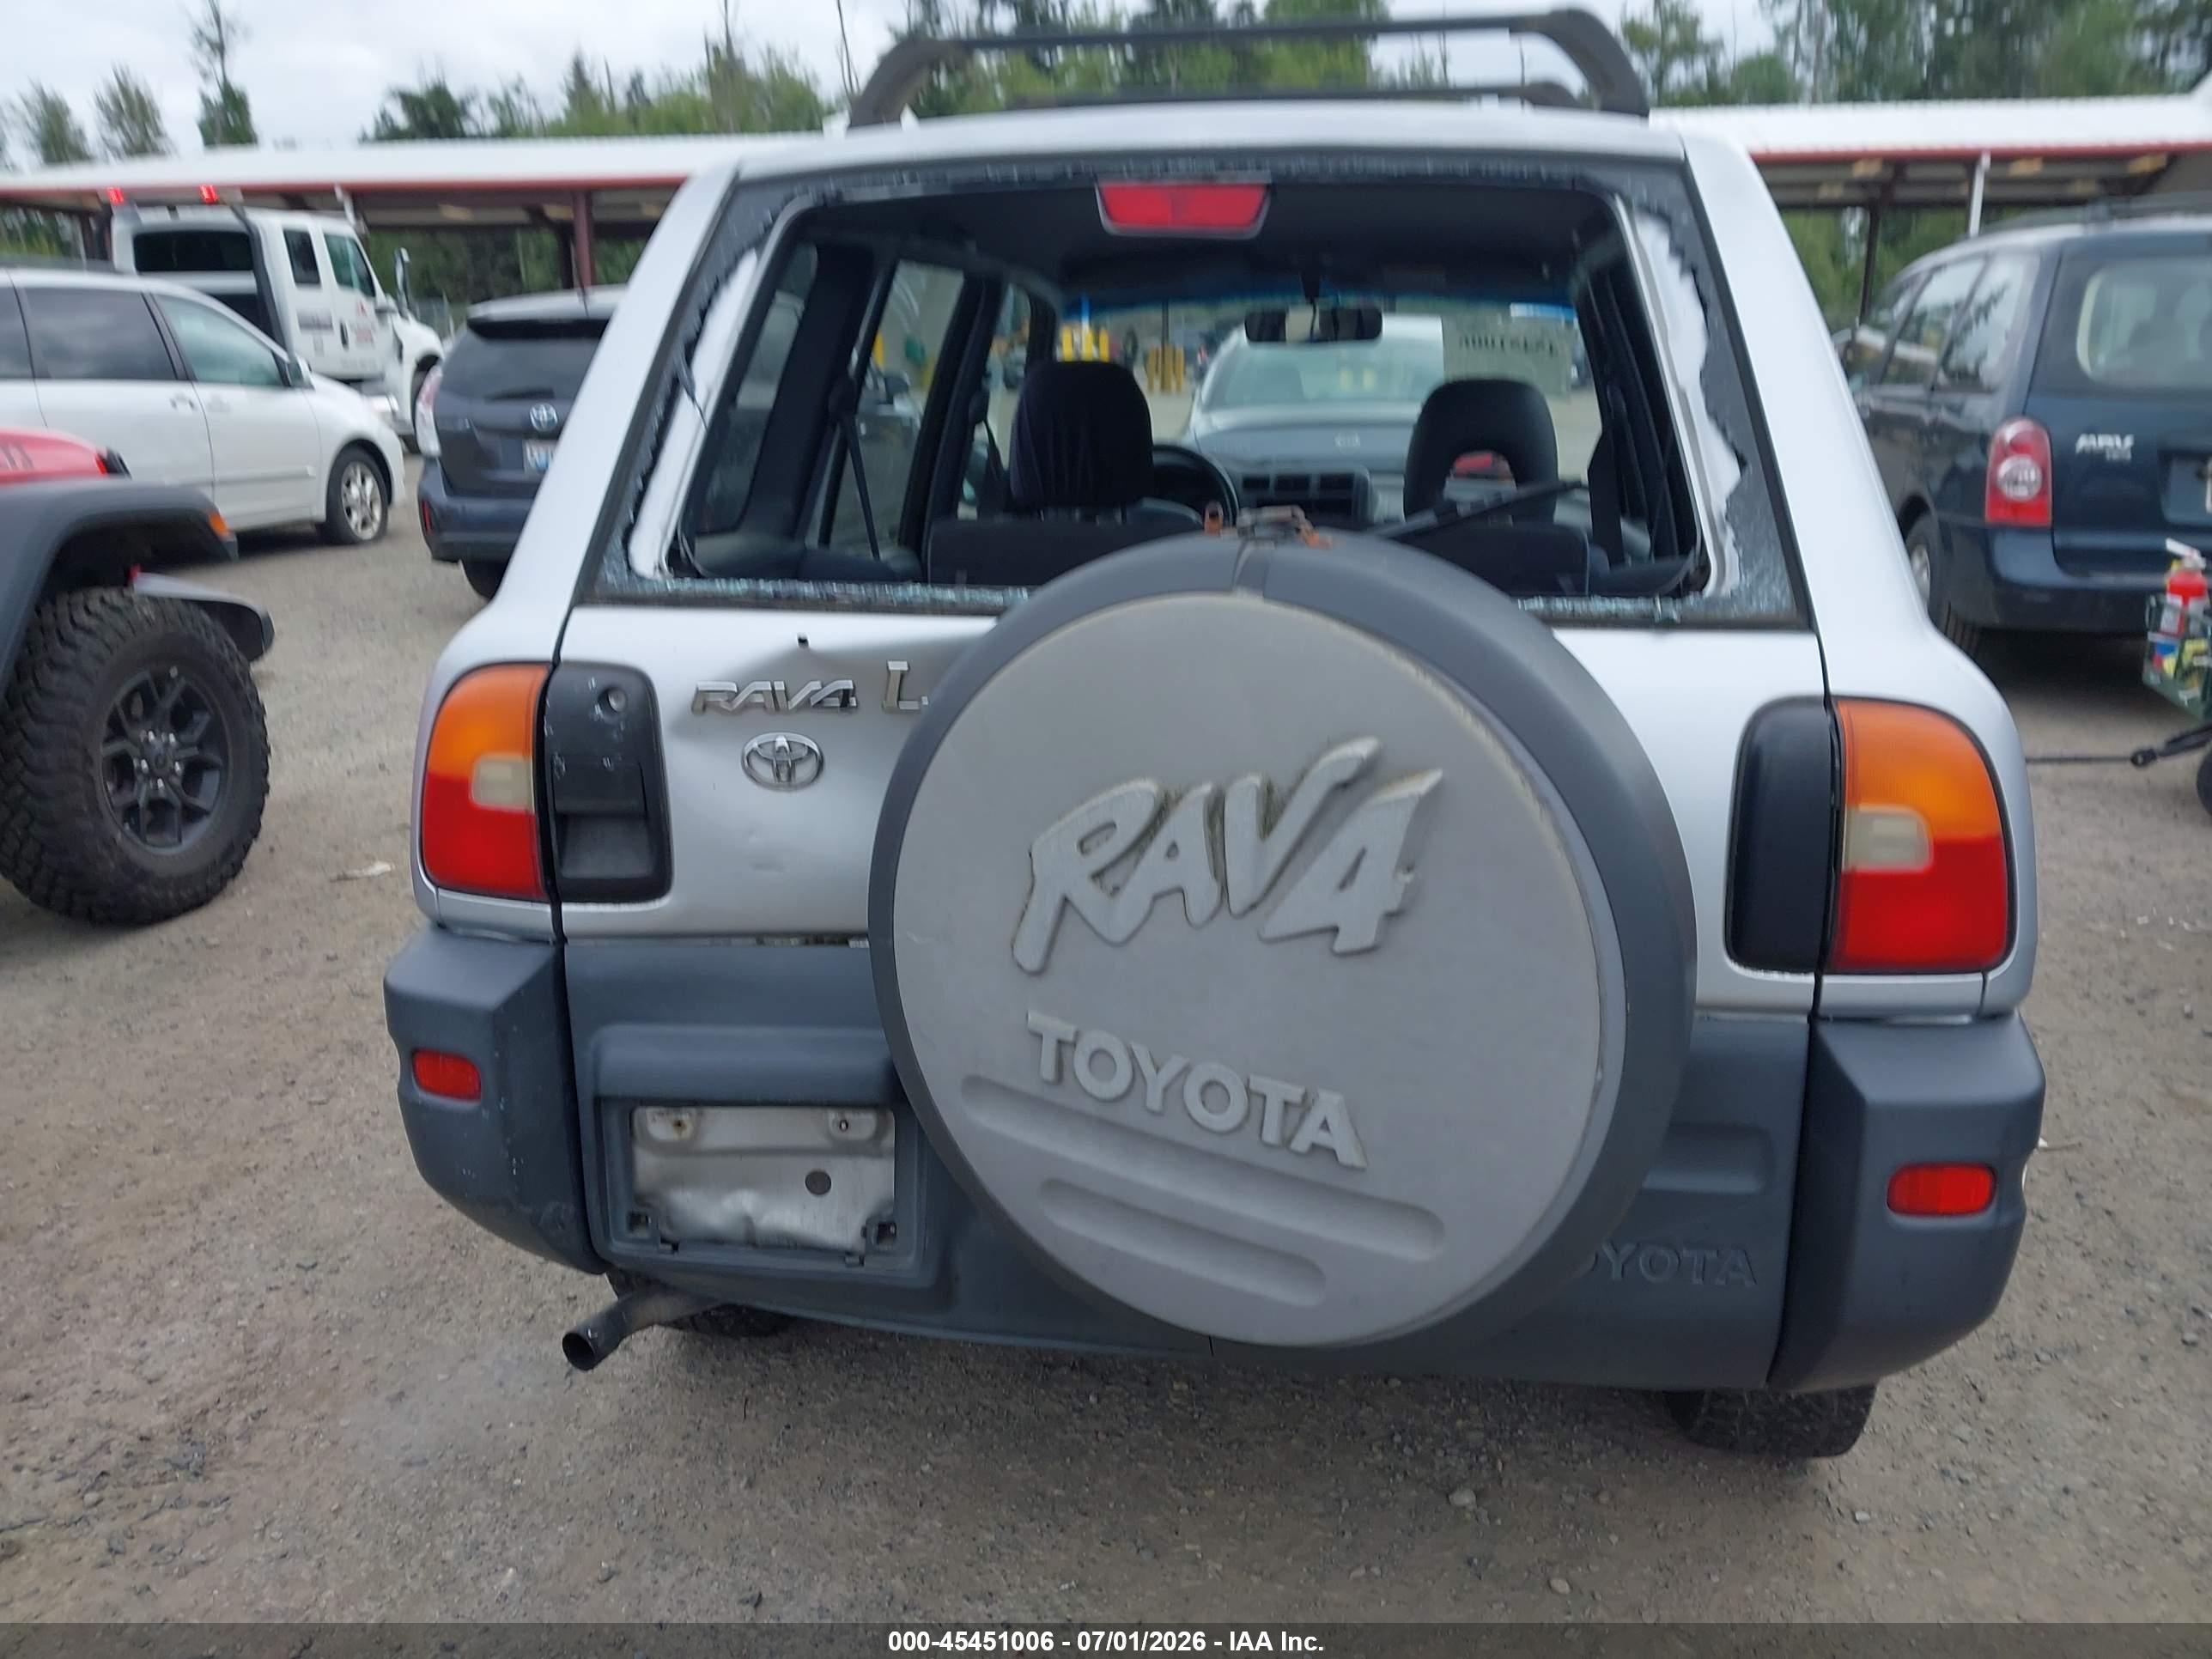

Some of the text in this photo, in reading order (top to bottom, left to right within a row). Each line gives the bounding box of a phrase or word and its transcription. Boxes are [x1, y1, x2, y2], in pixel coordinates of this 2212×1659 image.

[691, 680, 857, 713] RAV4
[1012, 737, 1443, 974] RAV4
[1027, 1012, 1367, 1169] TOYOTA
[1590, 1241, 1757, 1286] YOTA
